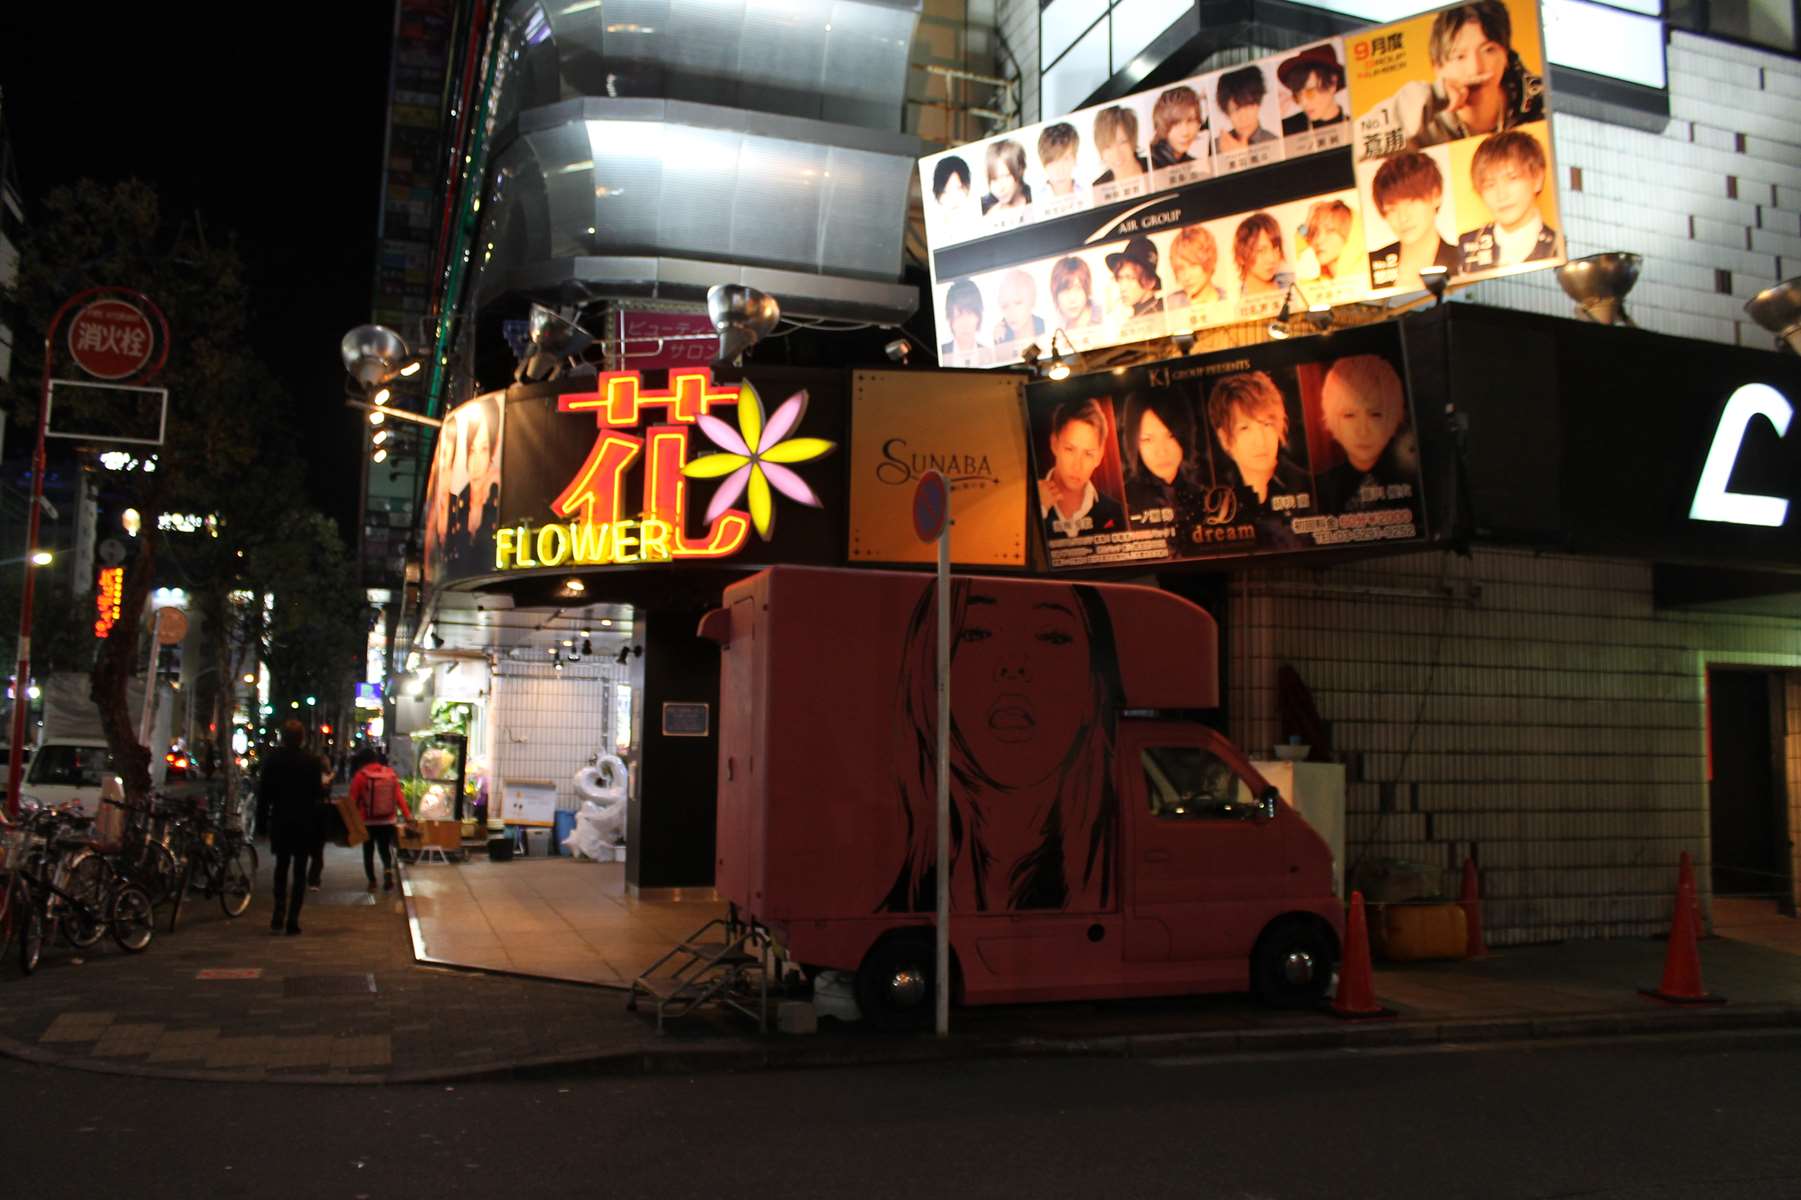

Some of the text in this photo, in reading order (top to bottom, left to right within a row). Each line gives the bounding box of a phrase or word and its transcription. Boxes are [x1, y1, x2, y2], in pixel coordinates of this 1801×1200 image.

[1354, 32, 1403, 60] 9月度
[1119, 210, 1181, 234] AIR GROUP
[78, 321, 145, 358] 消火栓
[670, 343, 716, 360] サロン
[551, 366, 752, 559] 花
[495, 519, 673, 569] FLOWER
[1191, 523, 1256, 544] dream
